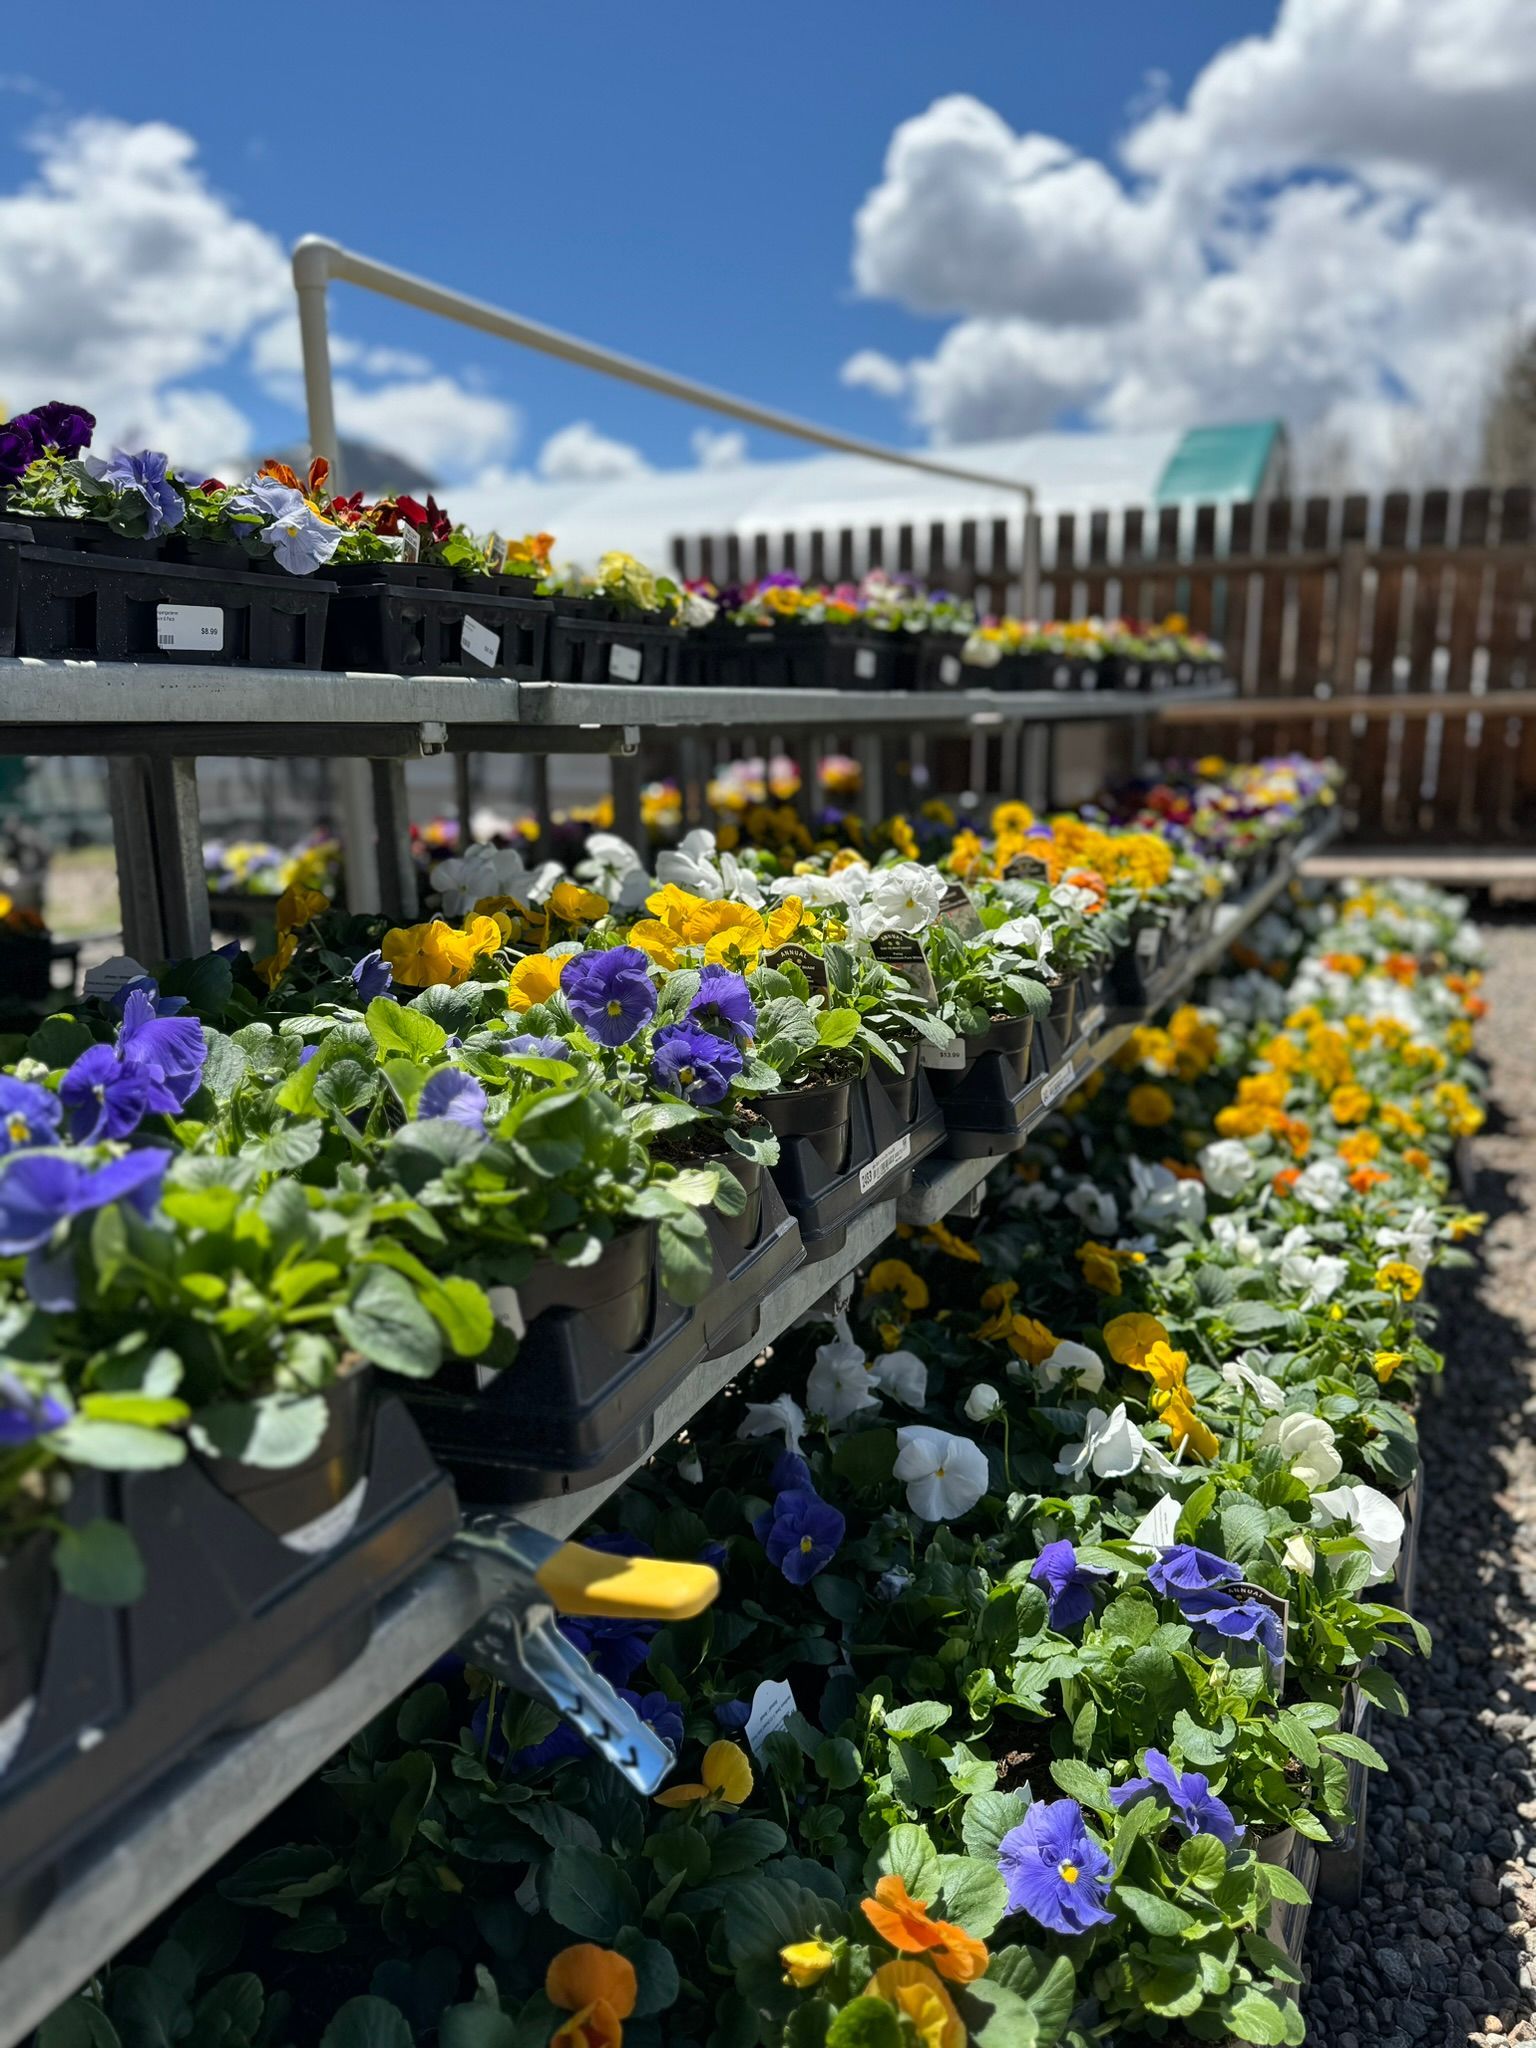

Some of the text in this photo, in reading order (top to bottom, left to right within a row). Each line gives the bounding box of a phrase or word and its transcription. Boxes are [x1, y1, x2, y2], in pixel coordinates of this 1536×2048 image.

[200, 627, 218, 636] $8.99
[881, 933, 903, 942] ANNUAL
[780, 949, 807, 960] ANNUAL
[1228, 1587, 1264, 1599] ANNUAL
